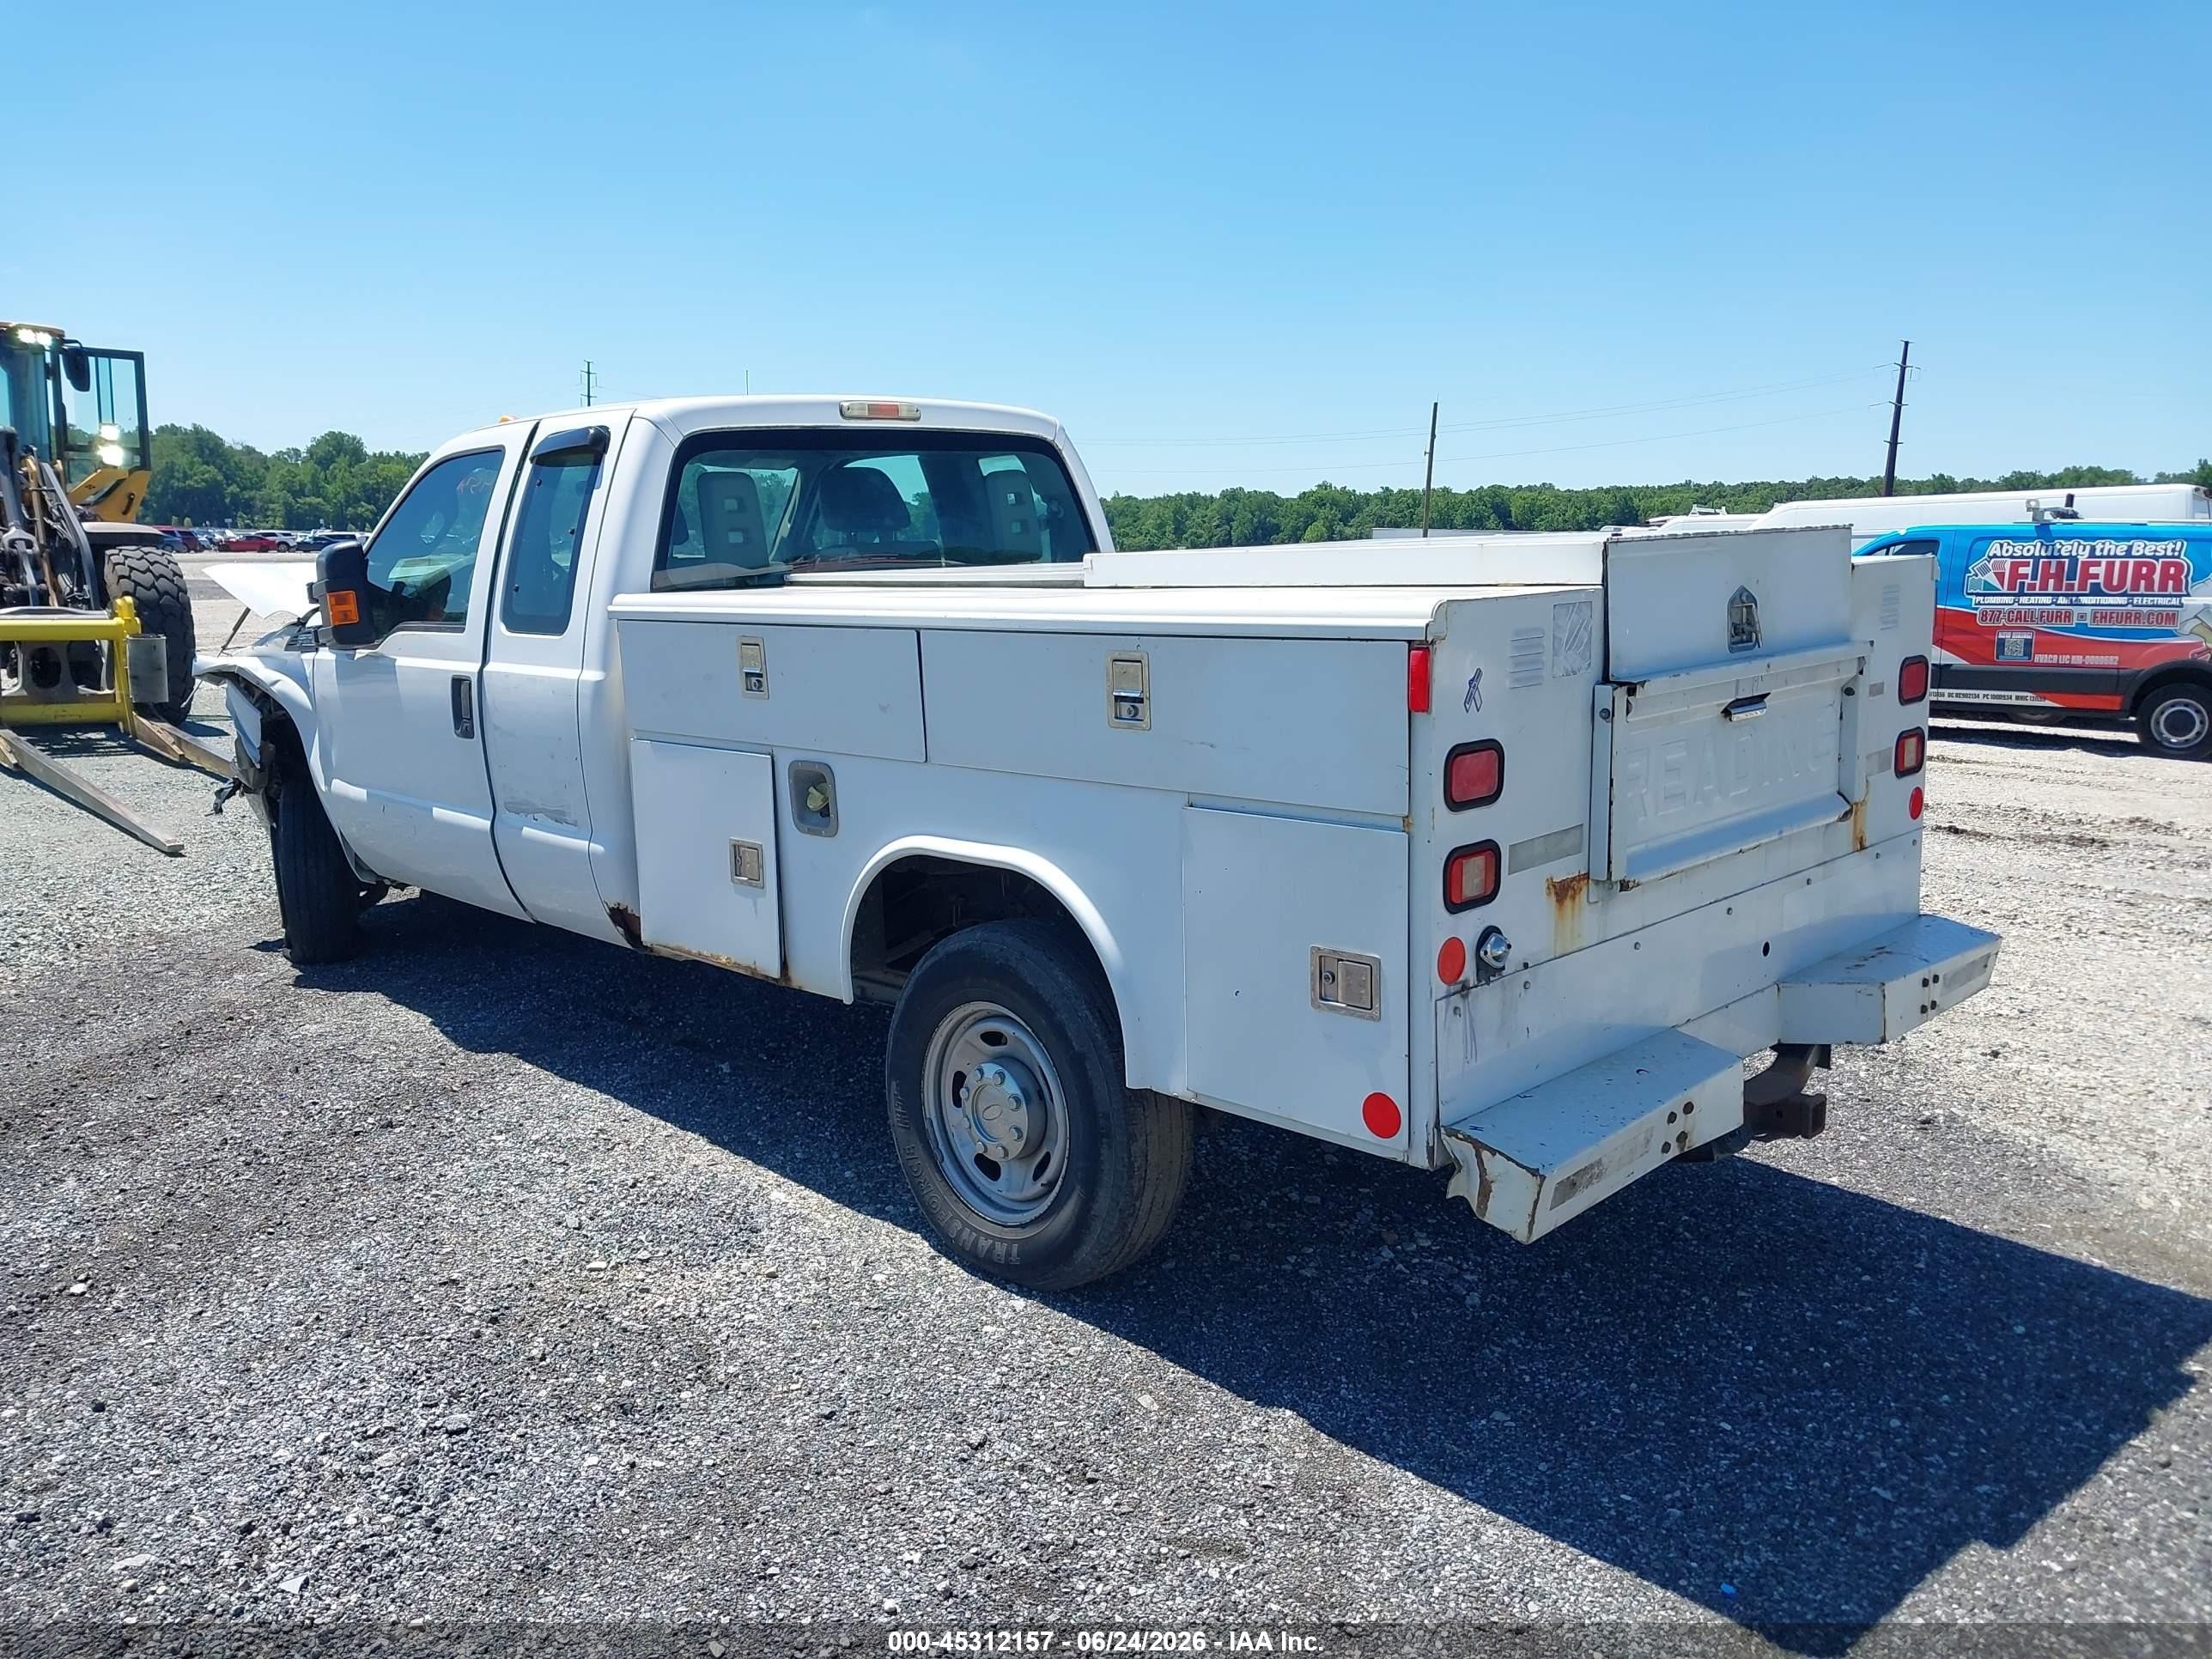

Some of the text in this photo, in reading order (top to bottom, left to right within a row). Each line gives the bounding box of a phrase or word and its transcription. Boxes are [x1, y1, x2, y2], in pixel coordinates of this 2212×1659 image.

[1990, 541, 2184, 558] Absolutely the Best!
[1976, 596, 2013, 605] PLUMBING
[2019, 596, 2051, 605] HEATING
[2133, 596, 2182, 605] ELECTRICAL
[1980, 609, 2072, 623] 877-CALL FURR
[2092, 610, 2176, 626] FHFURR.COM
[1625, 716, 1832, 822] READING
